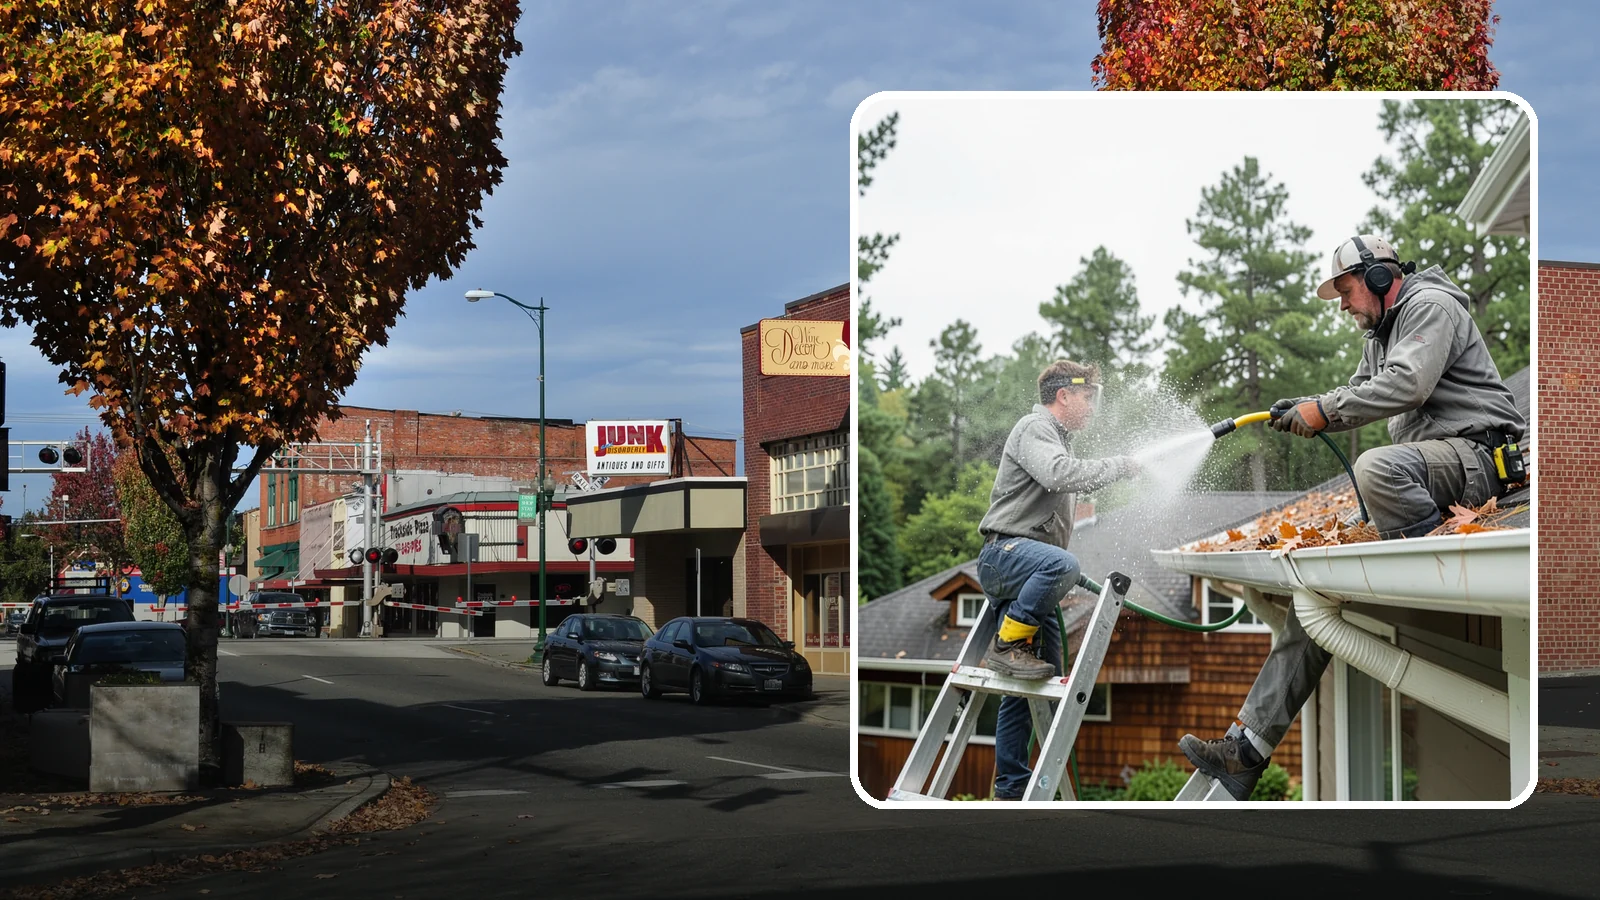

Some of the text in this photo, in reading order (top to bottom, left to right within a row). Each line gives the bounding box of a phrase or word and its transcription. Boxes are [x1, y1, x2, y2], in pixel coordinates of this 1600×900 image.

[765, 327, 831, 365] Decor
[596, 425, 665, 457] JUNK
[607, 446, 645, 454] DISORDERLY
[597, 460, 665, 470] ANTIQUES AND GIFTS
[414, 519, 429, 535] Pizza
